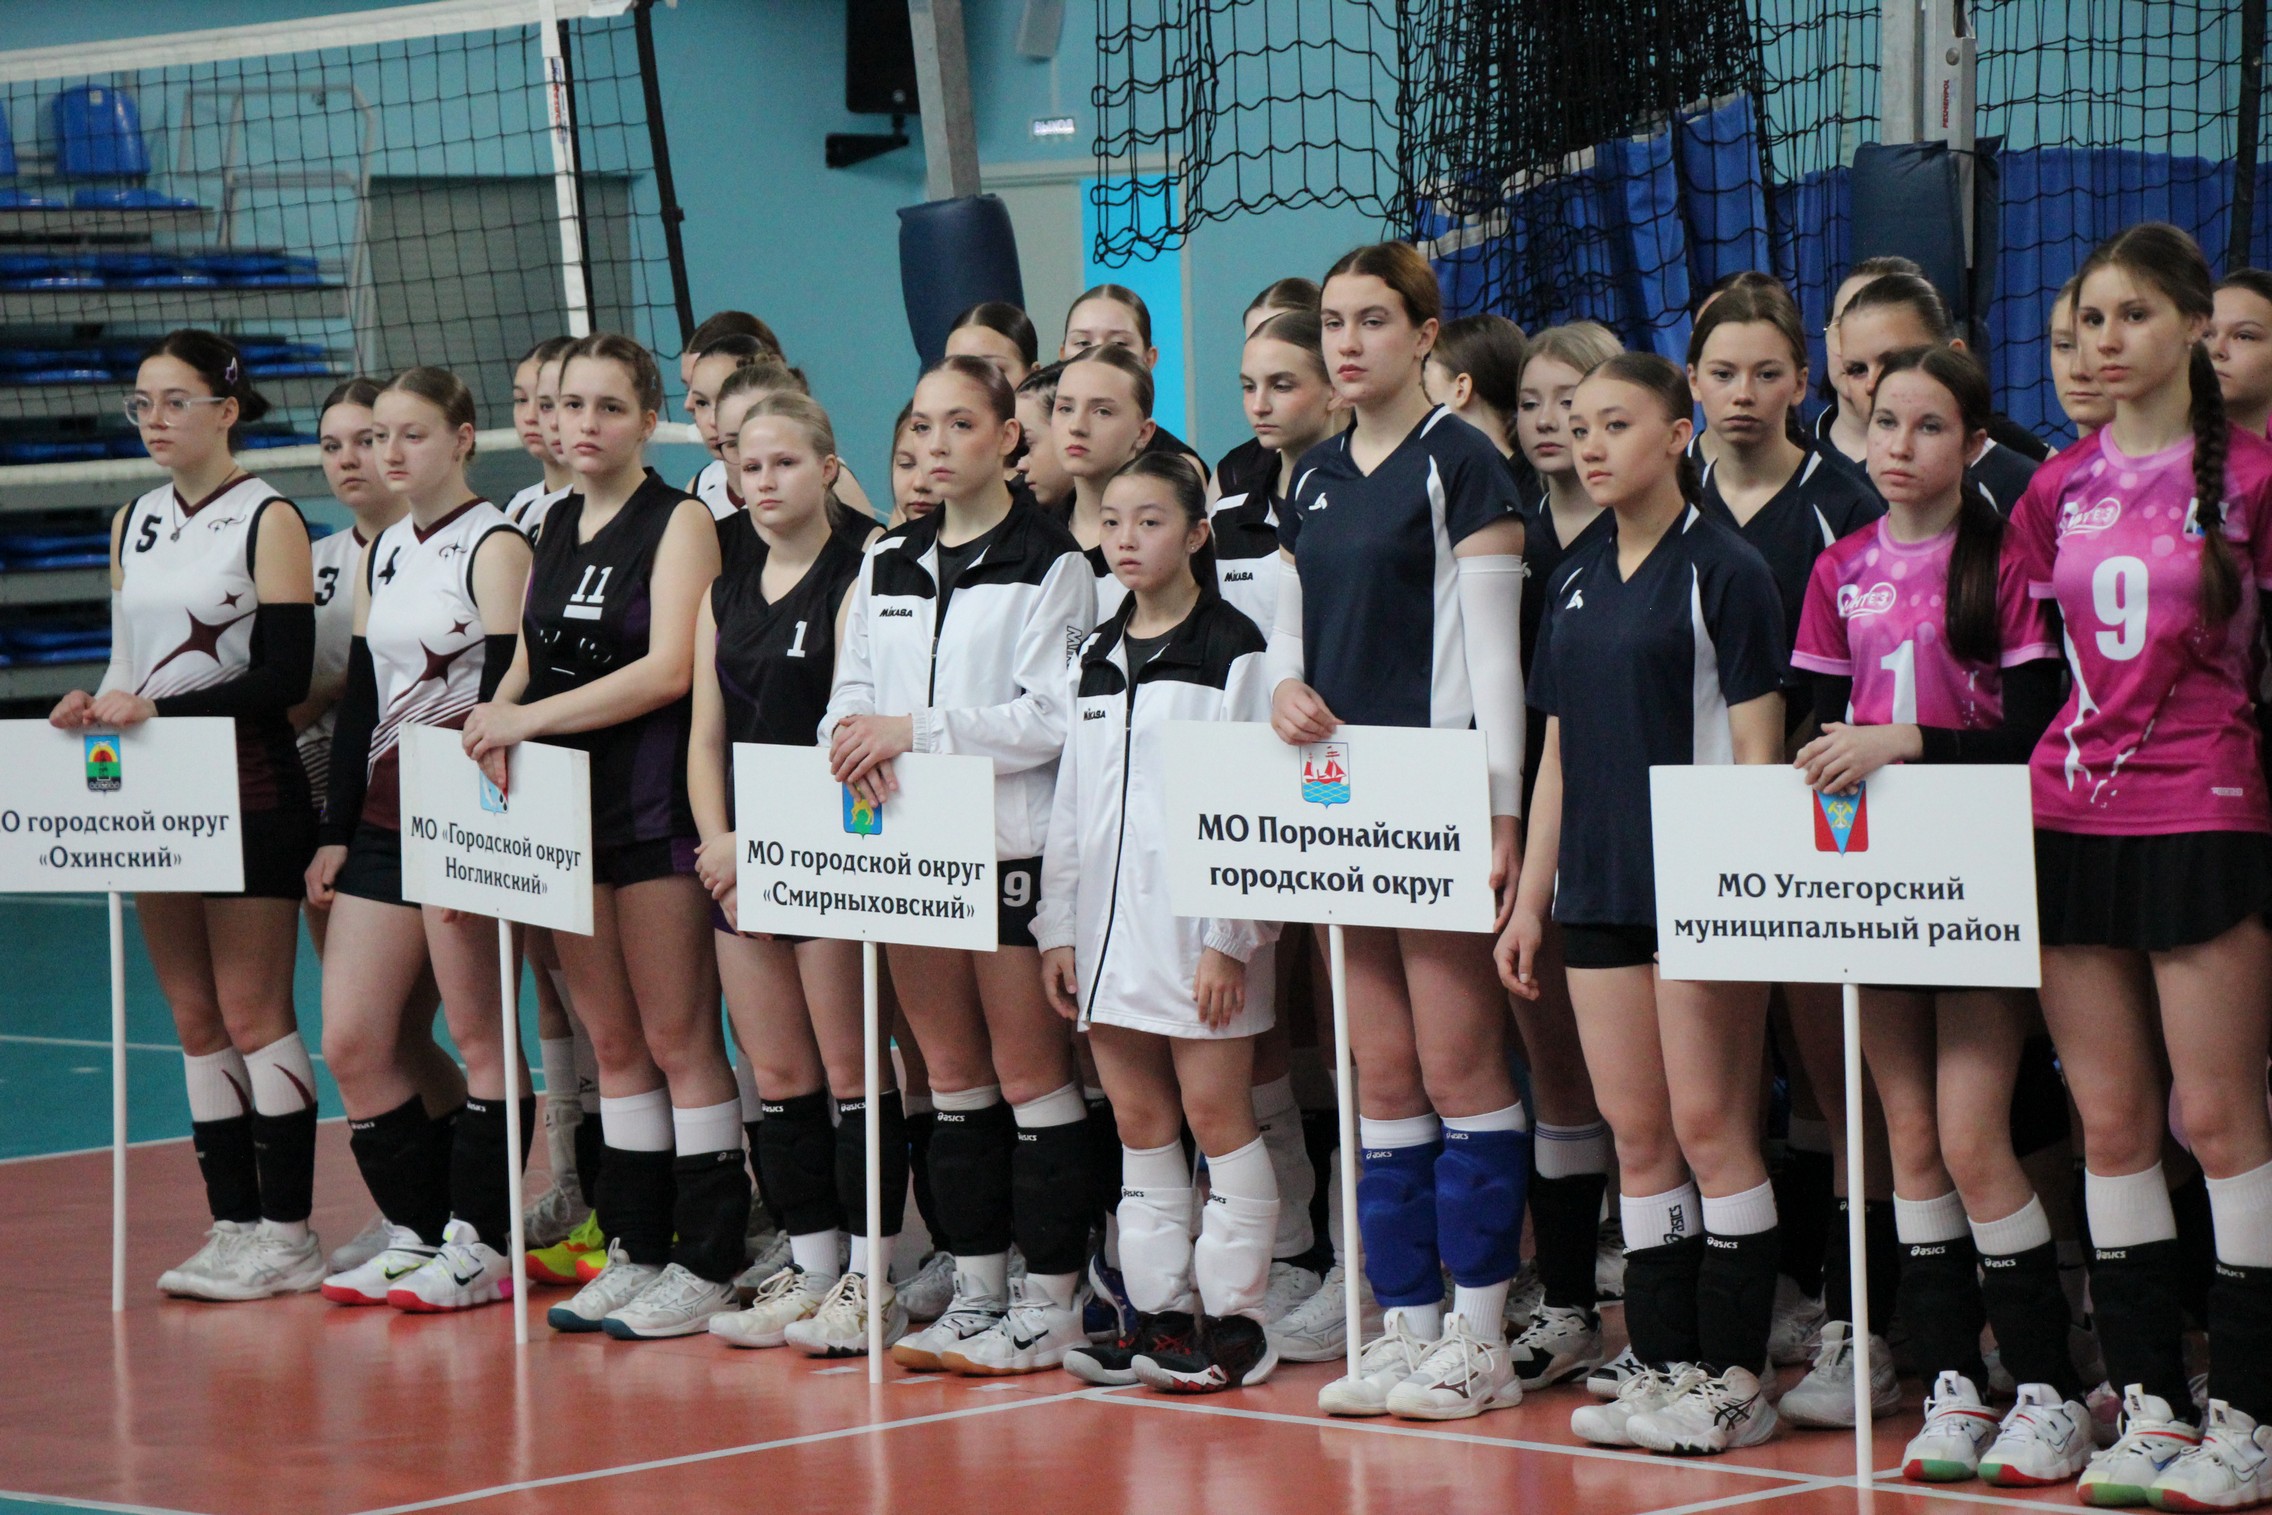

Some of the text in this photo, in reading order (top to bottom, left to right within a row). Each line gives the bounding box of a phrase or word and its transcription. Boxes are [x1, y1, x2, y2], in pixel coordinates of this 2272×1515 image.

[135, 514, 162, 553] 5
[314, 566, 339, 606] 3
[570, 565, 613, 603] 11
[2092, 555, 2149, 661] 9
[787, 621, 808, 658] 1
[1881, 640, 1917, 724] 1
[0, 810, 230, 838] О городской округ
[411, 816, 582, 871] МО «Городской округ
[1197, 813, 1461, 852] МО Поронайский
[39, 845, 182, 868] «Охинский»
[445, 856, 548, 895] Ногликский»
[747, 840, 986, 886] МО городской округ
[763, 880, 975, 919] «Смирныховский»
[1002, 870, 1031, 908] 9
[1209, 865, 1454, 905] городской округ
[1717, 873, 1965, 906] МО Углегорский
[1674, 916, 2021, 947] муниципальный район
